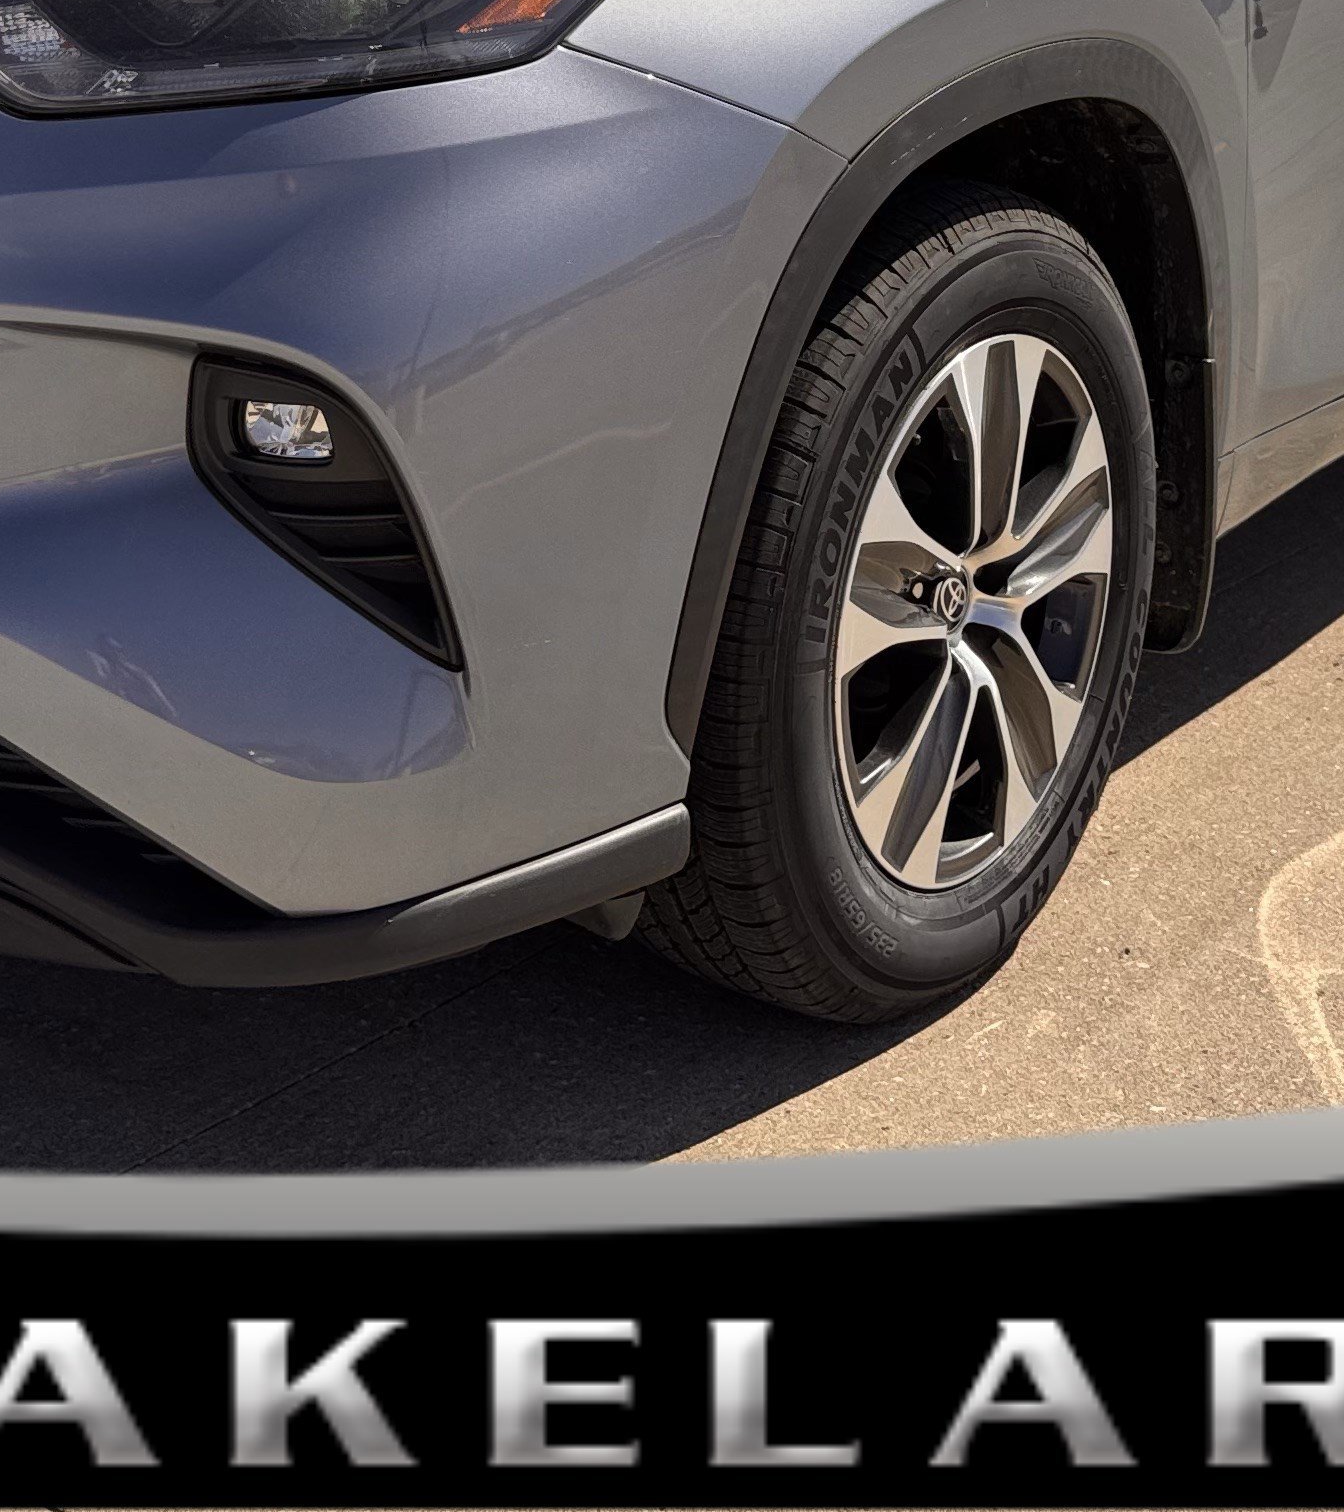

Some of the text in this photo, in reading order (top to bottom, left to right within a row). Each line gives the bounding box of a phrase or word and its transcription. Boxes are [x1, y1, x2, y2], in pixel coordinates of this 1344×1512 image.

[806, 349, 914, 644] IRONMAN
[829, 867, 900, 959] 235/65R18
[1010, 863, 1051, 935] HT
